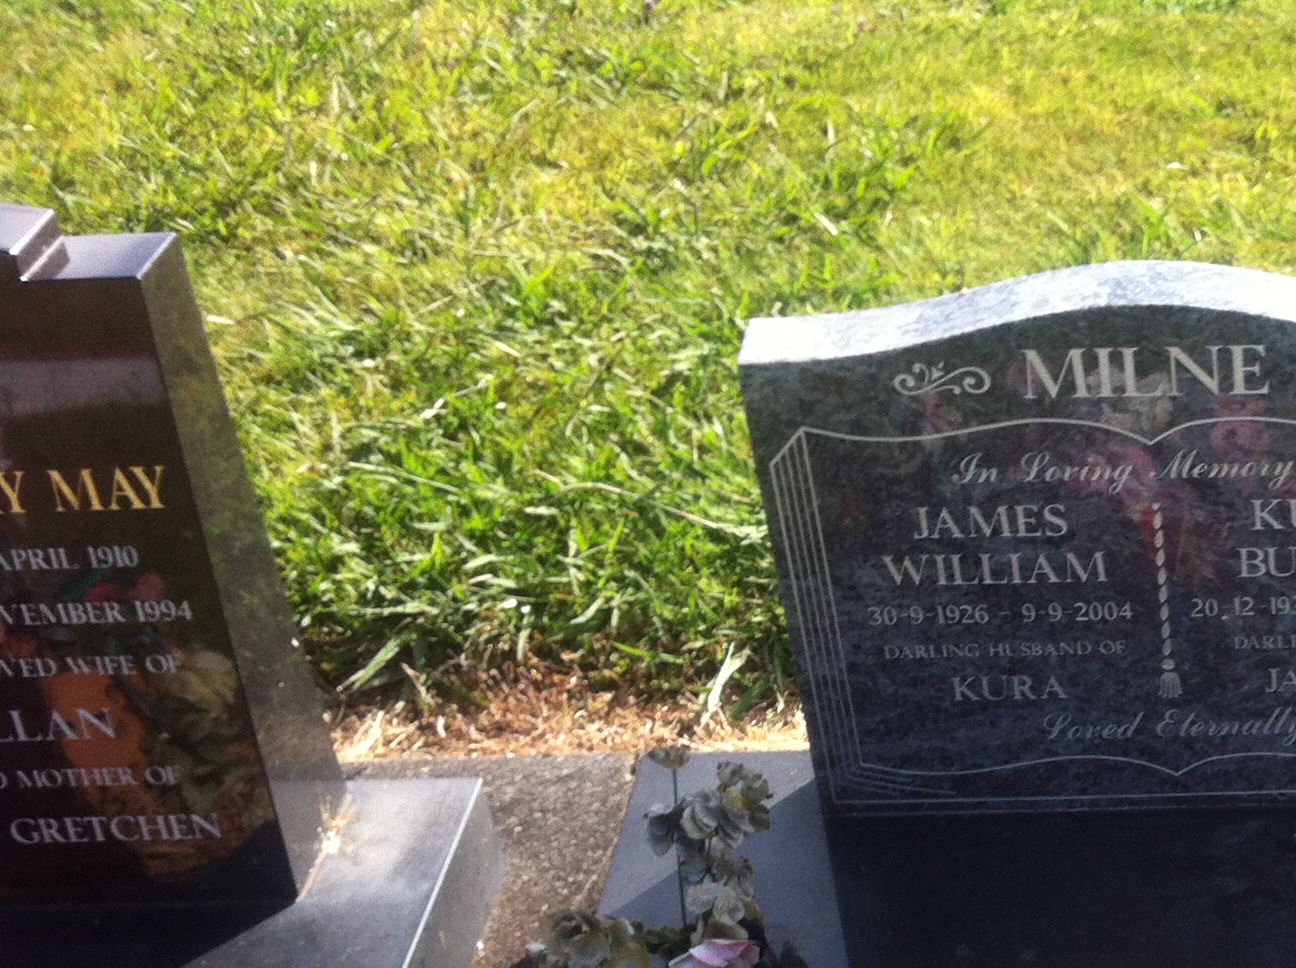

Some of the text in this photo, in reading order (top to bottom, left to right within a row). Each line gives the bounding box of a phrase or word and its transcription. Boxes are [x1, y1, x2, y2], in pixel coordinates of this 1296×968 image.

[1022, 345, 1269, 398] MILNE
[952, 452, 998, 483] In
[1021, 451, 1133, 493] Loving
[1157, 448, 1294, 490] Memory
[0, 465, 166, 515] Y MAY
[914, 504, 1068, 539] JAMES
[87, 545, 139, 568] 1910
[881, 550, 1108, 586] WILLIAM
[134, 599, 193, 623] 1994
[867, 604, 989, 626] 30-9-1926
[1021, 601, 1133, 623] 9-9-2004
[64, 654, 138, 676] WIFE
[145, 653, 180, 674] OF
[884, 640, 1127, 660] DARLING HUSBAND OF
[952, 674, 1068, 701] KURA
[0, 708, 117, 742] LAN
[1043, 711, 1145, 740] Loved
[16, 765, 140, 789] MOTHER
[145, 764, 178, 786] OF
[9, 812, 222, 845] GRETCHEN
